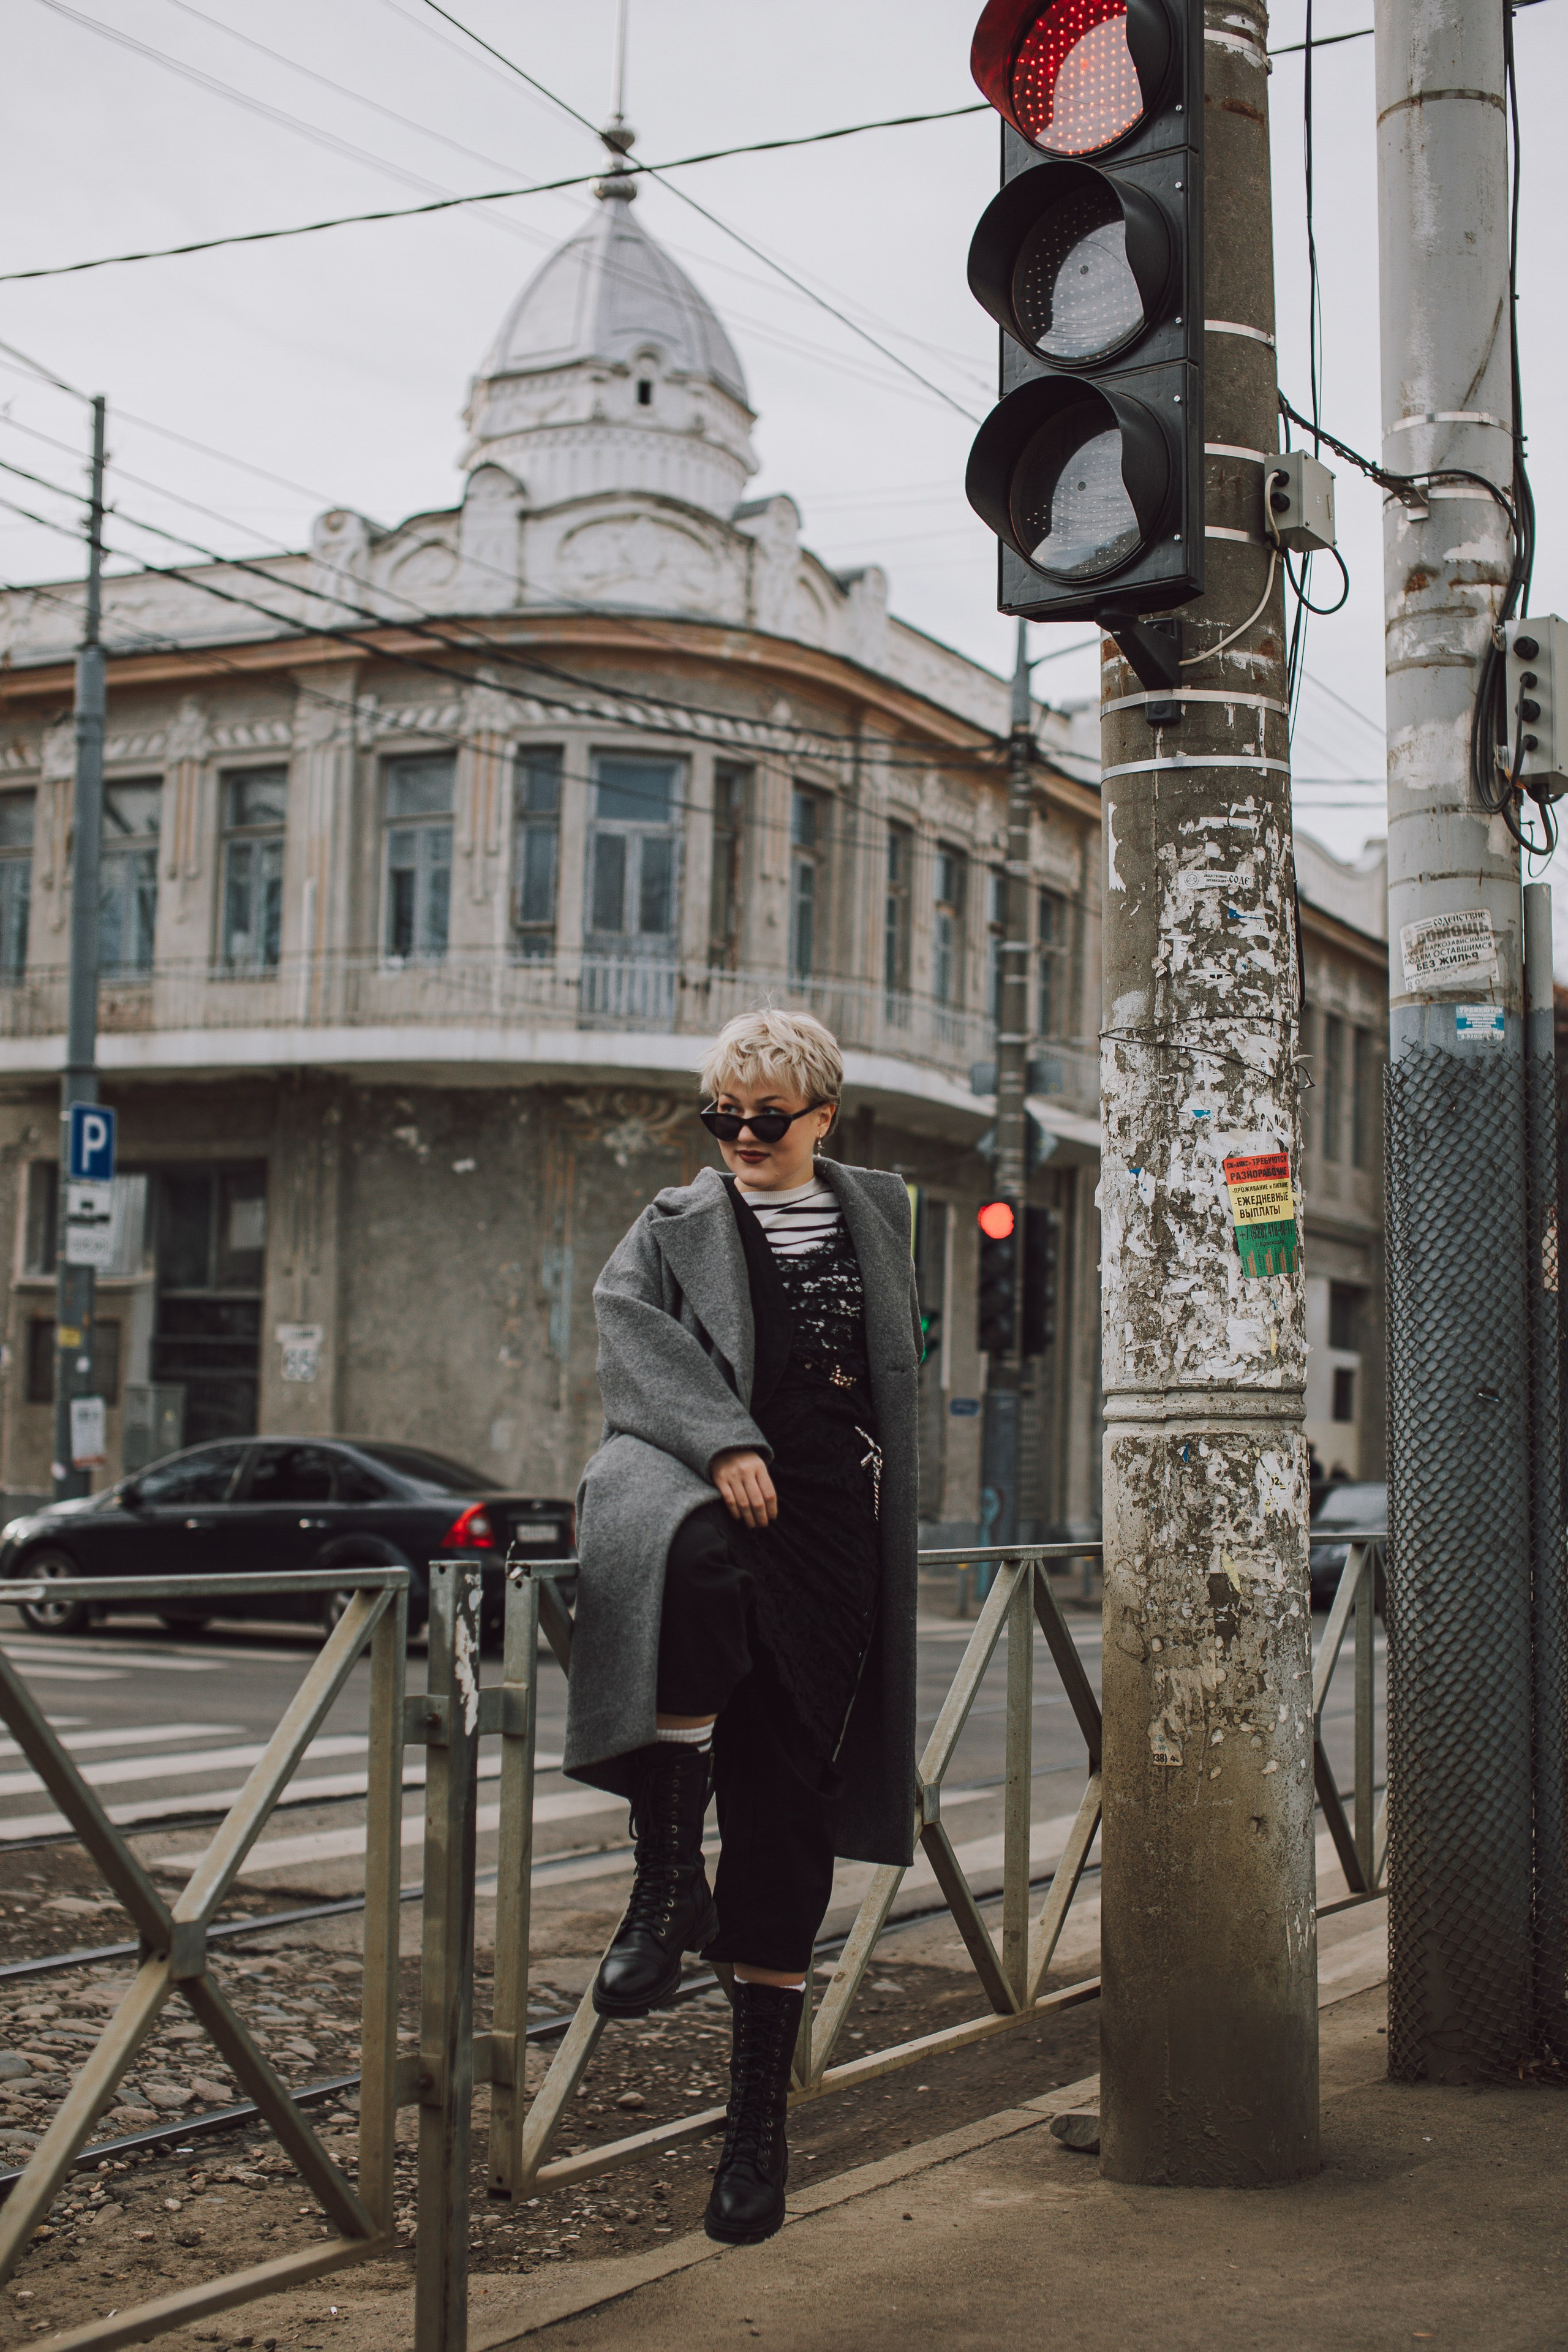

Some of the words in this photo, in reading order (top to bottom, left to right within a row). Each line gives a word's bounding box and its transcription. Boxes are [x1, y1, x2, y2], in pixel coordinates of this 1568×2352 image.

[1229, 875, 1255, 885] СОДЕ
[1417, 921, 1490, 944] ПОМОЩЬ
[1425, 936, 1491, 951] НАРКОЗАВИСИМЫМ
[1433, 942, 1492, 957] ОСТАВШИМСЯ
[1417, 959, 1436, 971] БЕЗ
[82, 1113, 108, 1172] P
[1251, 1155, 1287, 1166] ТРЕБУЮТСЯ
[1230, 1166, 1287, 1181] РАЗНОРАБОЧИЕ
[1240, 1205, 1281, 1219] ВЫПЛАТЫ
[1239, 1226, 1248, 1240] +7
